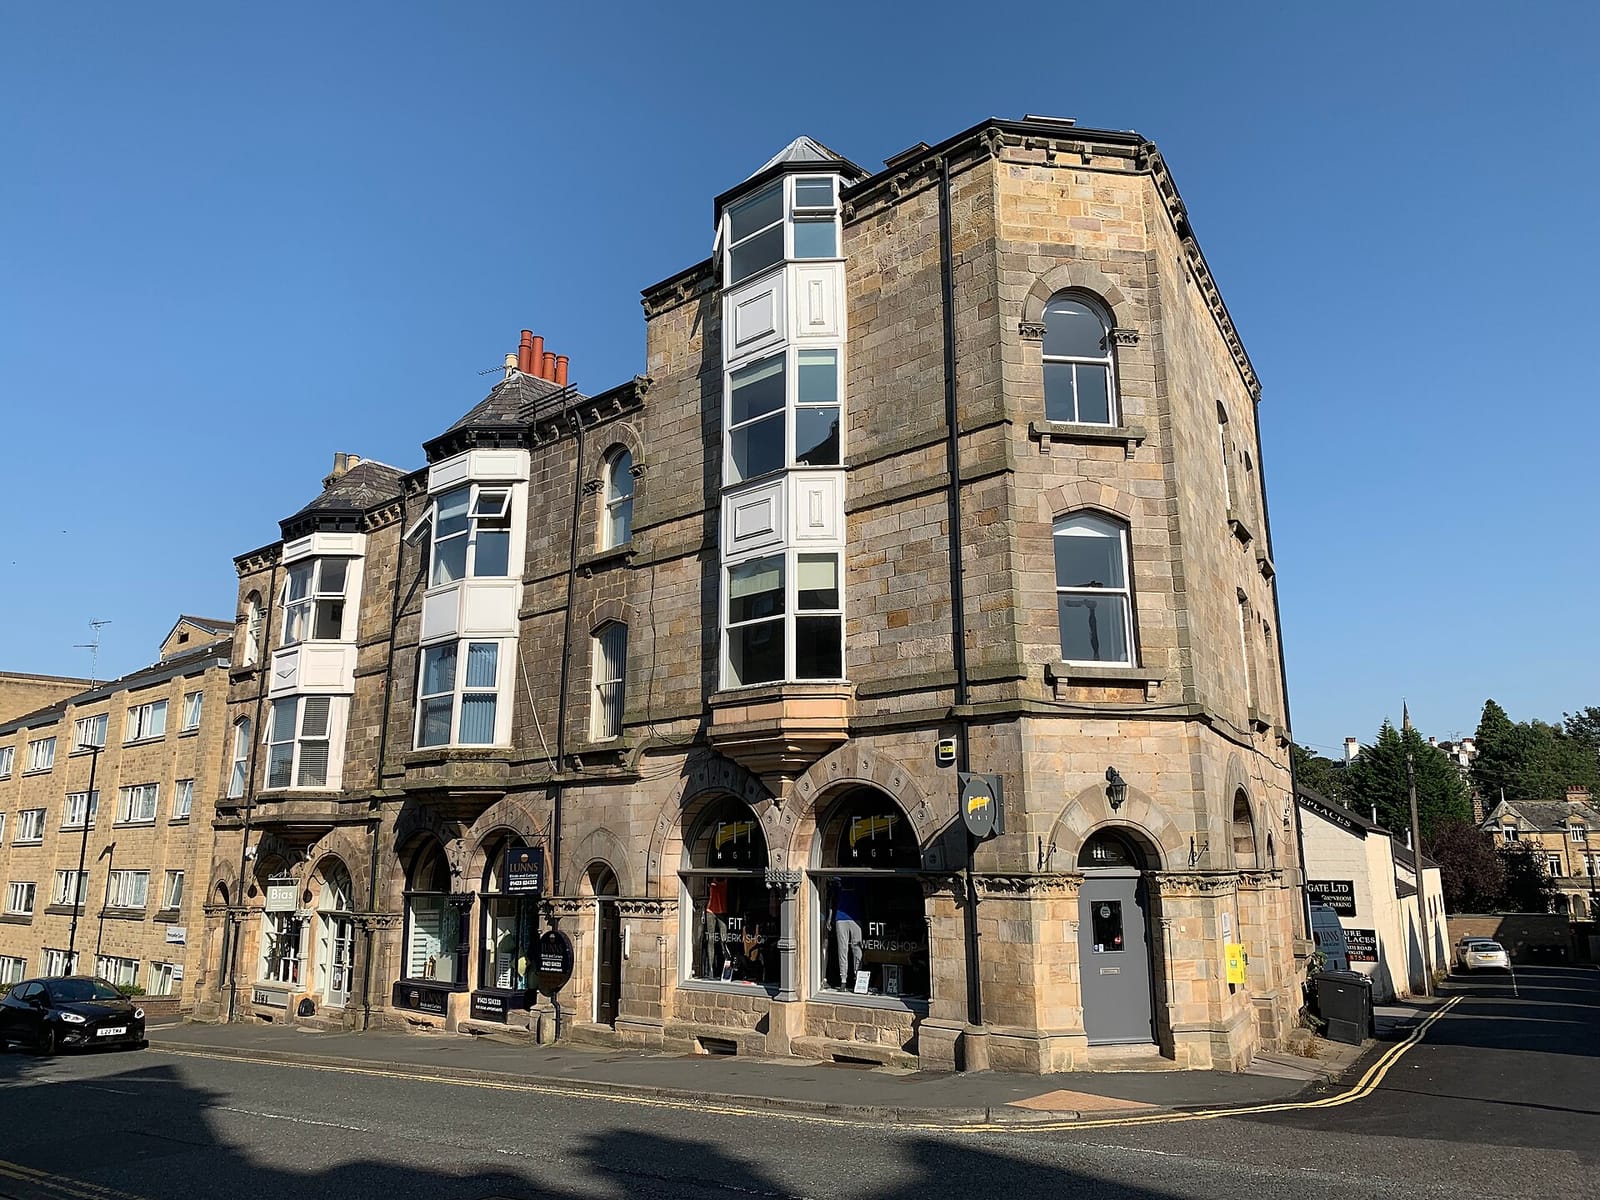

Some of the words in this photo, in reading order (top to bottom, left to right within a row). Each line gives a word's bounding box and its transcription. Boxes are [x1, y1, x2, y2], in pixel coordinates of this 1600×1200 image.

[968, 796, 989, 814] FIT
[718, 821, 754, 844] FIT
[852, 815, 895, 841] FIT
[509, 862, 538, 872] LUNNS
[271, 888, 294, 900] Bias
[1307, 883, 1330, 893] GATE
[728, 917, 743, 930] FIT
[869, 921, 887, 936] FIT
